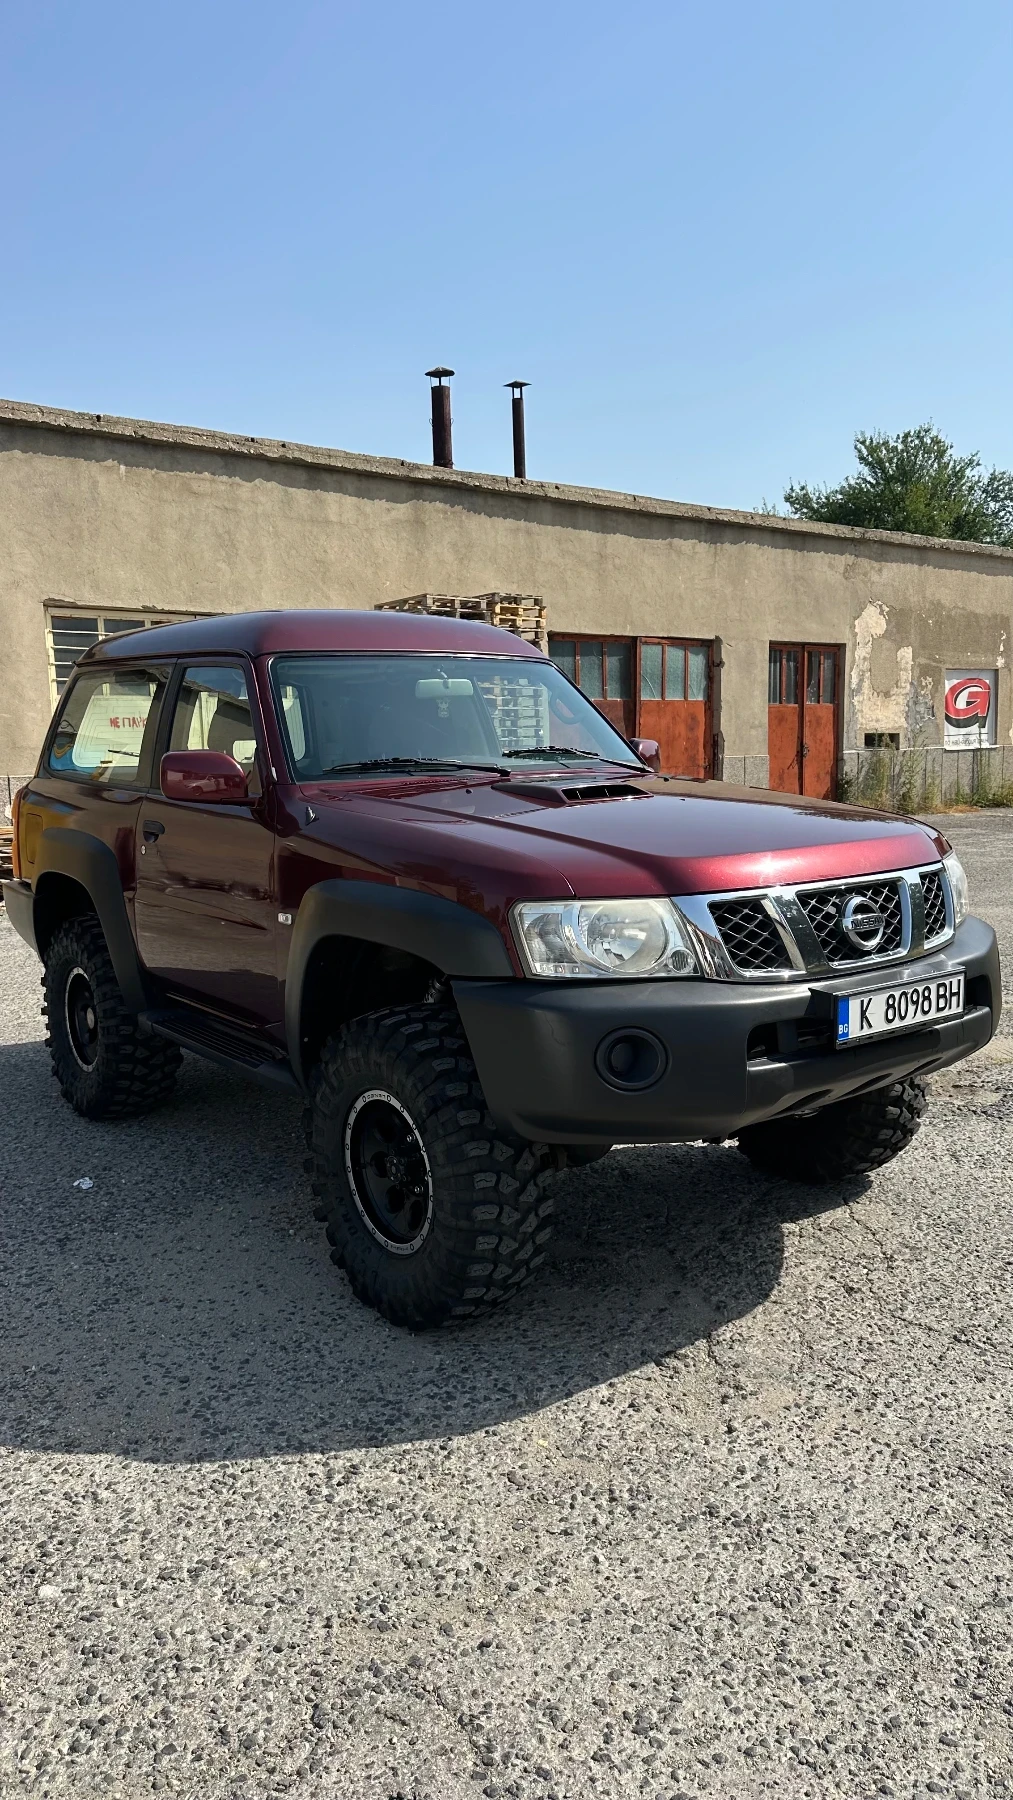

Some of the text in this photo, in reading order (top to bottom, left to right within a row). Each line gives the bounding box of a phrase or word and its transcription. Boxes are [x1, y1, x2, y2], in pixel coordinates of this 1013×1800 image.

[850, 915, 885, 930] NISSAN
[884, 985, 933, 1024] 8098
[838, 1023, 849, 1035] BG
